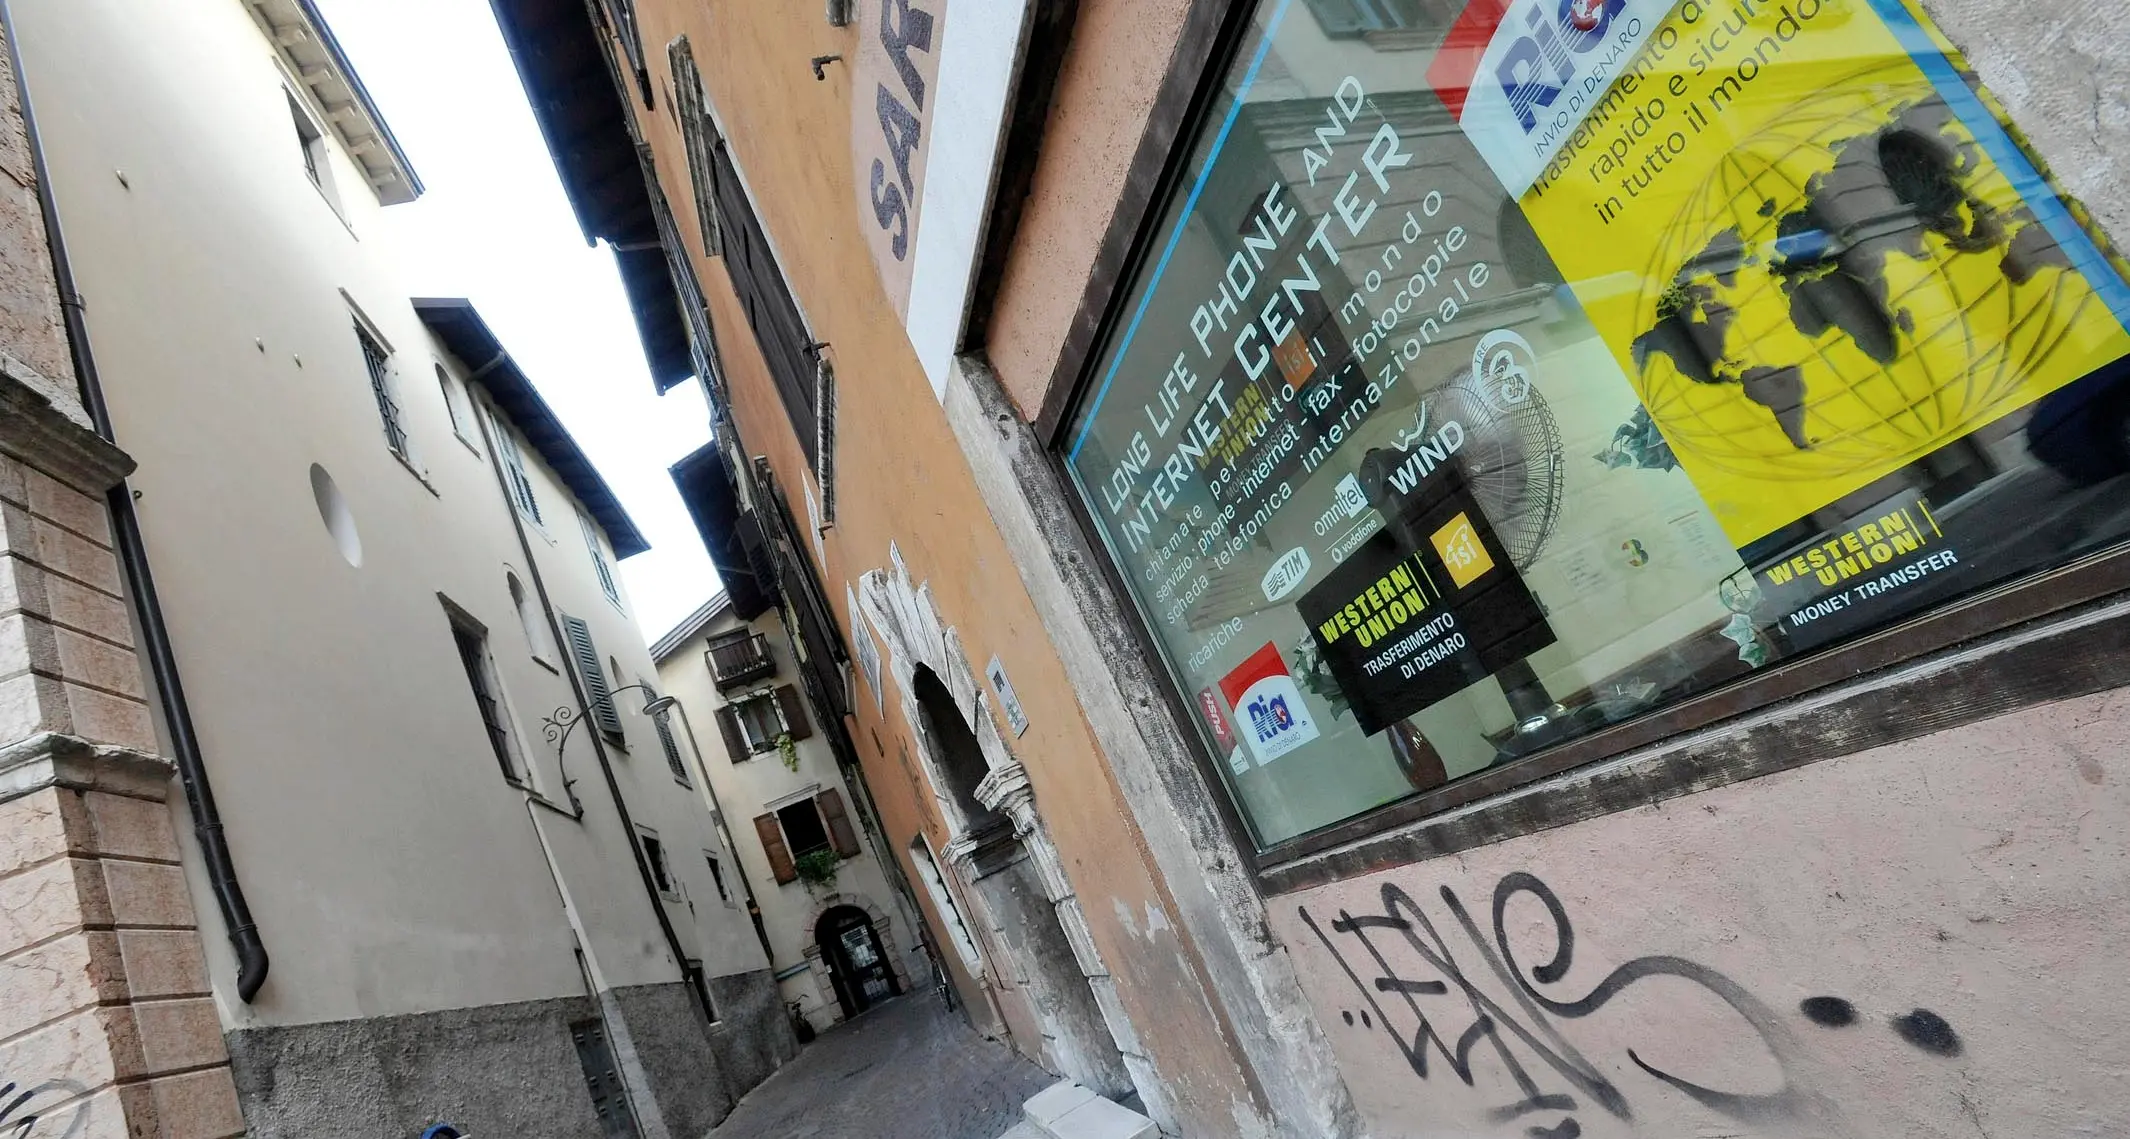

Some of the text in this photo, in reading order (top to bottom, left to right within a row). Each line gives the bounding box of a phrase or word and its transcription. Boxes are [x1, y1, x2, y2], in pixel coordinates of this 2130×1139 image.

[1534, 17, 1642, 158] INVIO DI DENARO
[1589, 0, 1769, 184] rapido e sicur
[1594, 0, 1830, 225] in tutto il mondo
[1101, 75, 1365, 516] LONG LIFE PHONE AND
[1120, 123, 1414, 554] INTERNET CENTER
[1145, 189, 1442, 581] chiamate per tutto il mondo
[1198, 503, 1236, 557] phone
[1240, 423, 1300, 499] internet
[1307, 374, 1342, 416] fax
[1352, 225, 1468, 363] fotocopie
[1167, 260, 1490, 625] scheda telefonica internazionale
[1388, 419, 1464, 497] WIND
[1314, 481, 1364, 537] omnitel
[1341, 519, 1378, 553] vodafone
[1281, 551, 1304, 581] TIM
[1766, 510, 1909, 588] WESTERN
[1817, 531, 1920, 589] UNION
[1318, 564, 1412, 645] WESTERN
[1354, 587, 1425, 648] UNION
[1790, 549, 1959, 628] MONEY TRANSFER
[1188, 615, 1244, 674] ricariche
[1362, 612, 1455, 677] TRASFERIMENTO
[1400, 632, 1466, 680] DI DENARO
[1203, 692, 1225, 735] PUSH
[1247, 693, 1295, 743] Ria
